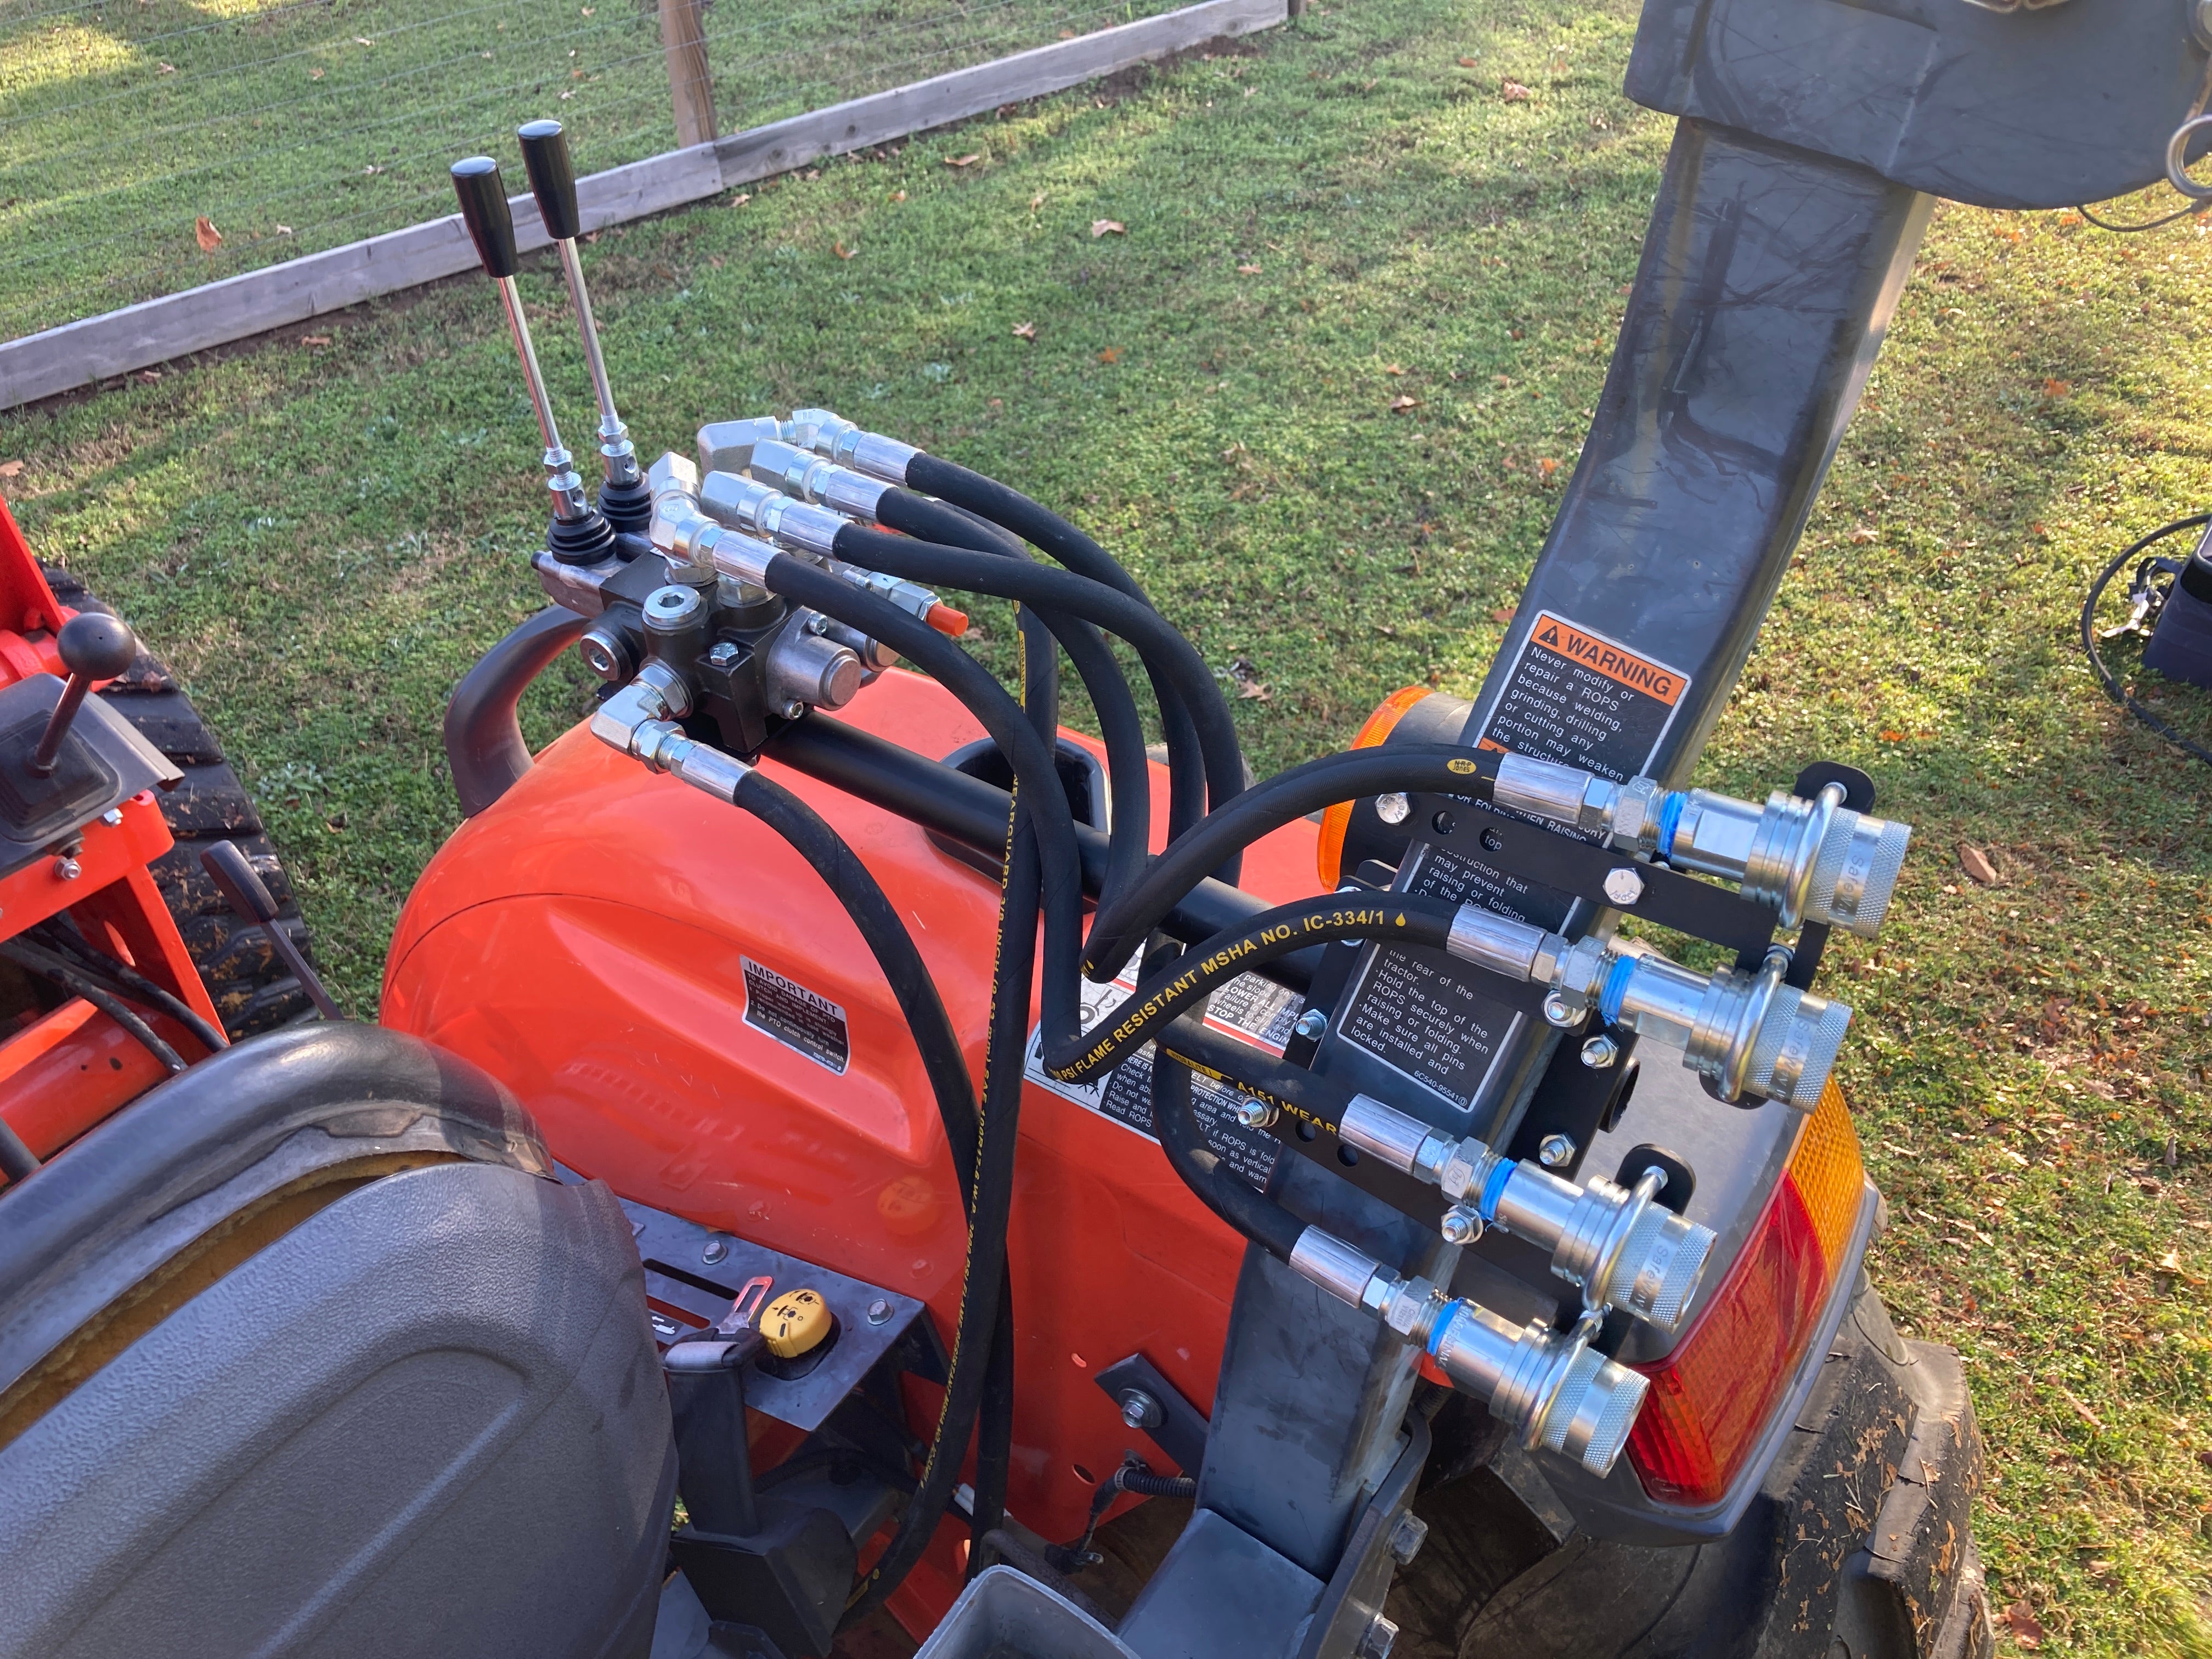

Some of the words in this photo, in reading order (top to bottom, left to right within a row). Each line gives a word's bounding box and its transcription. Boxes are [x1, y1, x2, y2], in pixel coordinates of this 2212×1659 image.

[1531, 646, 1567, 670] Never
[1573, 668, 1614, 691] modify
[1620, 691, 1634, 702] or
[1567, 634, 1672, 696] WARNING
[1517, 673, 1567, 703] because
[1575, 702, 1623, 732] welding,
[1524, 662, 1560, 684] repair
[1566, 682, 1574, 690] a
[1581, 689, 1619, 712] ROPS
[1505, 703, 1519, 713] or
[1524, 713, 1564, 737] cutting
[1571, 734, 1594, 751] any
[1510, 689, 1561, 720] grinding,
[1566, 714, 1607, 742] drilling
[1492, 727, 1510, 743] the
[1498, 716, 1539, 740] portion
[1546, 738, 1571, 756] may
[1579, 755, 1624, 781] weaken
[1485, 835, 1502, 850] top
[1424, 879, 1436, 888] of
[1440, 886, 1457, 901] the
[1435, 855, 1458, 872] may
[1462, 870, 1505, 896] prevent
[1505, 876, 1528, 894] that
[1429, 867, 1465, 892] raising
[1471, 890, 1483, 899] or
[1489, 898, 1526, 922] folding
[994, 928, 1003, 972] INCH
[748, 961, 838, 1015] IMPORTANT
[1244, 974, 1277, 992] parking
[1383, 958, 1420, 985] tractor.
[1412, 961, 1434, 978] rear
[1440, 977, 1452, 987] of
[1455, 984, 1474, 1000] the
[748, 979, 772, 995] CLUTCH
[776, 994, 788, 1003] AND
[760, 979, 778, 992] AVOID
[781, 990, 807, 1008] DAMAGE
[823, 1012, 836, 1023] PTO
[1060, 1066, 1078, 1080] PSI
[1075, 1038, 1115, 1073] FLAME
[1113, 969, 1197, 1042] RESISTANT
[1200, 939, 1257, 975] MSHA
[1261, 924, 1298, 946] NO.
[1303, 910, 1384, 932] IC-334/1
[1220, 990, 1249, 1007] Failure
[1251, 1003, 1259, 1012] to
[1260, 1007, 1291, 1026] comply
[1224, 984, 1259, 1002] LOWER
[1259, 1000, 1276, 1011] ALL
[757, 1011, 766, 1019] the
[769, 1018, 781, 1028] PTO
[783, 1025, 801, 1039] clutch
[803, 1036, 823, 1051] control
[758, 1003, 765, 1011] Do
[780, 1015, 815, 1039] continuously
[1207, 1004, 1234, 1019] STOP
[1238, 1017, 1257, 1030] THE
[1214, 998, 1243, 1014] wheels
[1273, 1024, 1290, 1035] and
[1367, 992, 1402, 1019] raising
[1408, 1017, 1420, 1028] or
[1425, 1025, 1462, 1054] folding.
[1373, 981, 1406, 1005] ROPS
[1410, 1005, 1455, 1034] securely
[1460, 1032, 1489, 1054] when
[1408, 987, 1425, 1002] the
[1430, 1000, 1448, 1015] top
[1454, 1014, 1466, 1025] of
[1470, 1023, 1488, 1039] the
[1351, 1025, 1386, 1053] locked.
[1356, 1016, 1374, 1030] are
[1379, 1028, 1424, 1059] installed
[1427, 1058, 1449, 1075] and
[1395, 1024, 1419, 1042] sure
[1426, 1041, 1437, 1054] all
[1442, 1052, 1465, 1070] pins
[1117, 1073, 1136, 1087] when
[1121, 1063, 1144, 1080] Check
[1210, 1081, 1234, 1096] before
[1109, 1091, 1130, 1105] Raise
[1133, 1103, 1147, 1114] and
[1113, 1081, 1123, 1091] Do
[1126, 1089, 1139, 1099] not
[1190, 1085, 1226, 1107] PROTECTION
[1106, 1100, 1126, 1115] Read
[1129, 1111, 1152, 1128] ROPS
[1199, 1101, 1217, 1114] area
[1221, 1111, 1237, 1122] and
[1222, 1133, 1247, 1150] ROPS
[1250, 1146, 1257, 1156] is
[1229, 1150, 1239, 1159] as
[1243, 1156, 1271, 1175] vertical
[1229, 1161, 1244, 1173] and
